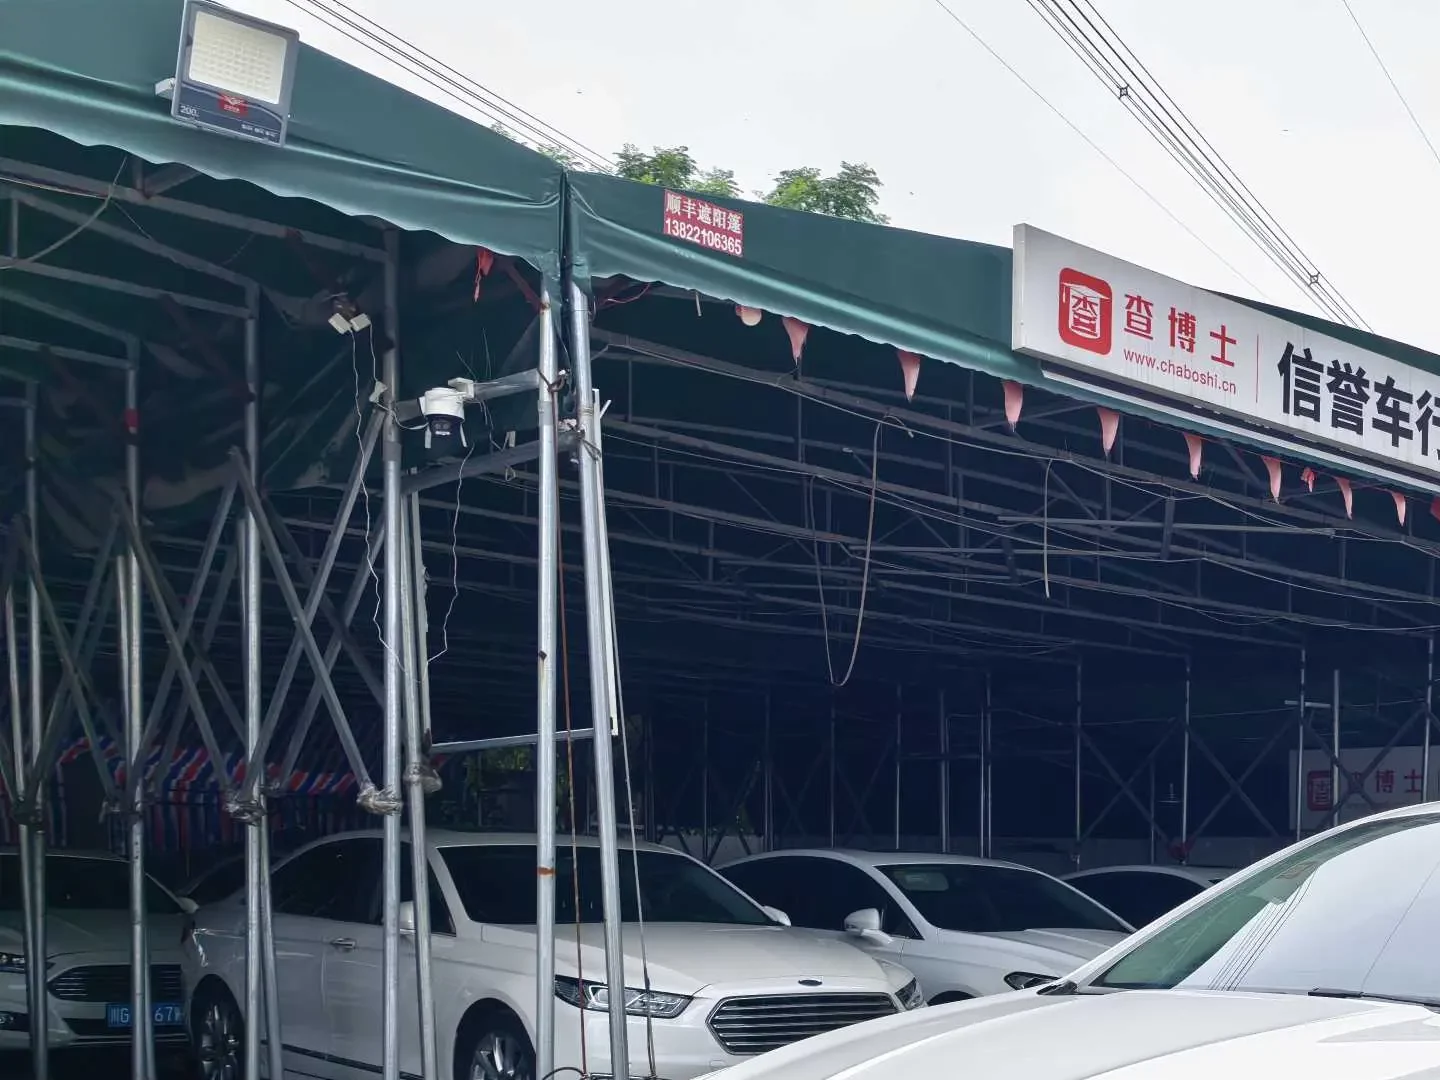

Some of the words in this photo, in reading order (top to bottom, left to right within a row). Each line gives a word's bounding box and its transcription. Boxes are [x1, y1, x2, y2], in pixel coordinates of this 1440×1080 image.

[666, 193, 742, 234] 顺丰遮阳篷
[665, 218, 742, 255] 13822106365
[1124, 294, 1237, 367] 查博士
[1123, 348, 1237, 395] www.chaboshi.cn
[1351, 769, 1424, 794] 博士
[110, 1006, 184, 1024] 川G67
